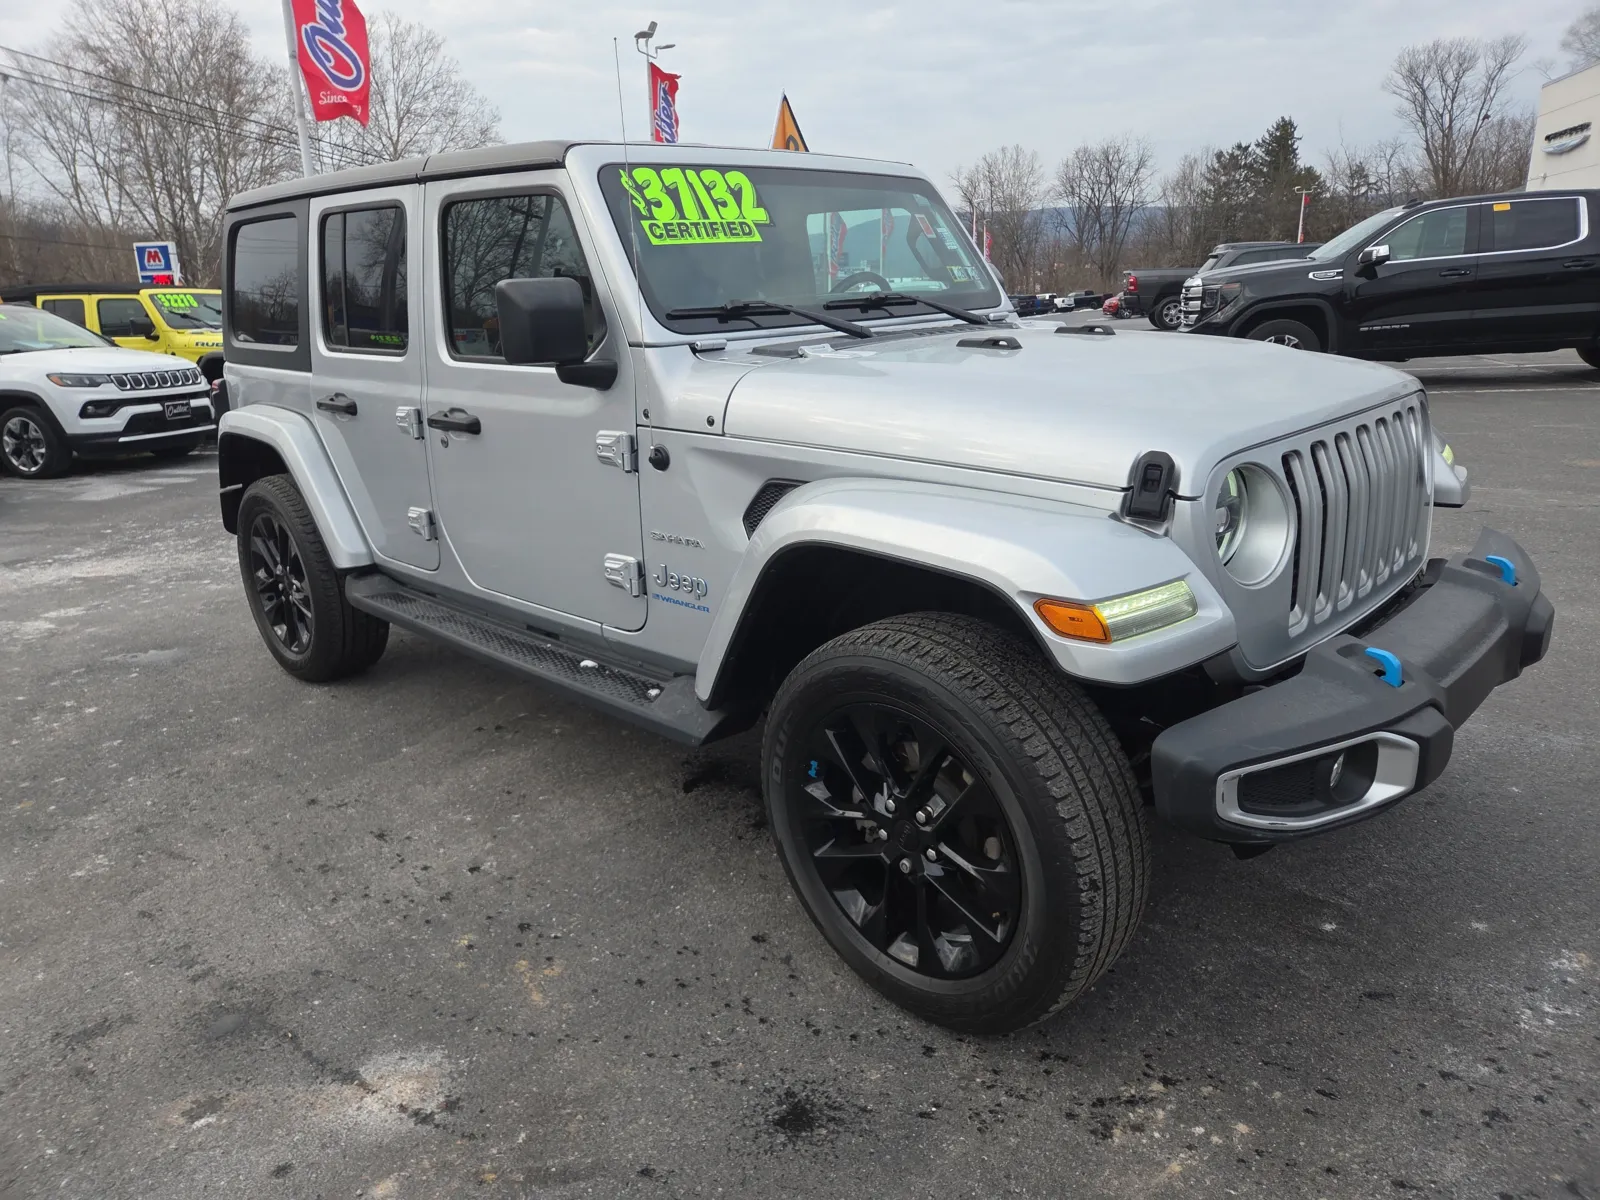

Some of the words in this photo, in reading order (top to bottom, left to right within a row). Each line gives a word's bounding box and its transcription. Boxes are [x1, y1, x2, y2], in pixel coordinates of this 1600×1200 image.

[319, 91, 347, 104] Since
[619, 167, 770, 224] $37132
[648, 221, 755, 241] CERTIFIED
[651, 530, 706, 549] SAHARA
[653, 563, 708, 600] Jeep
